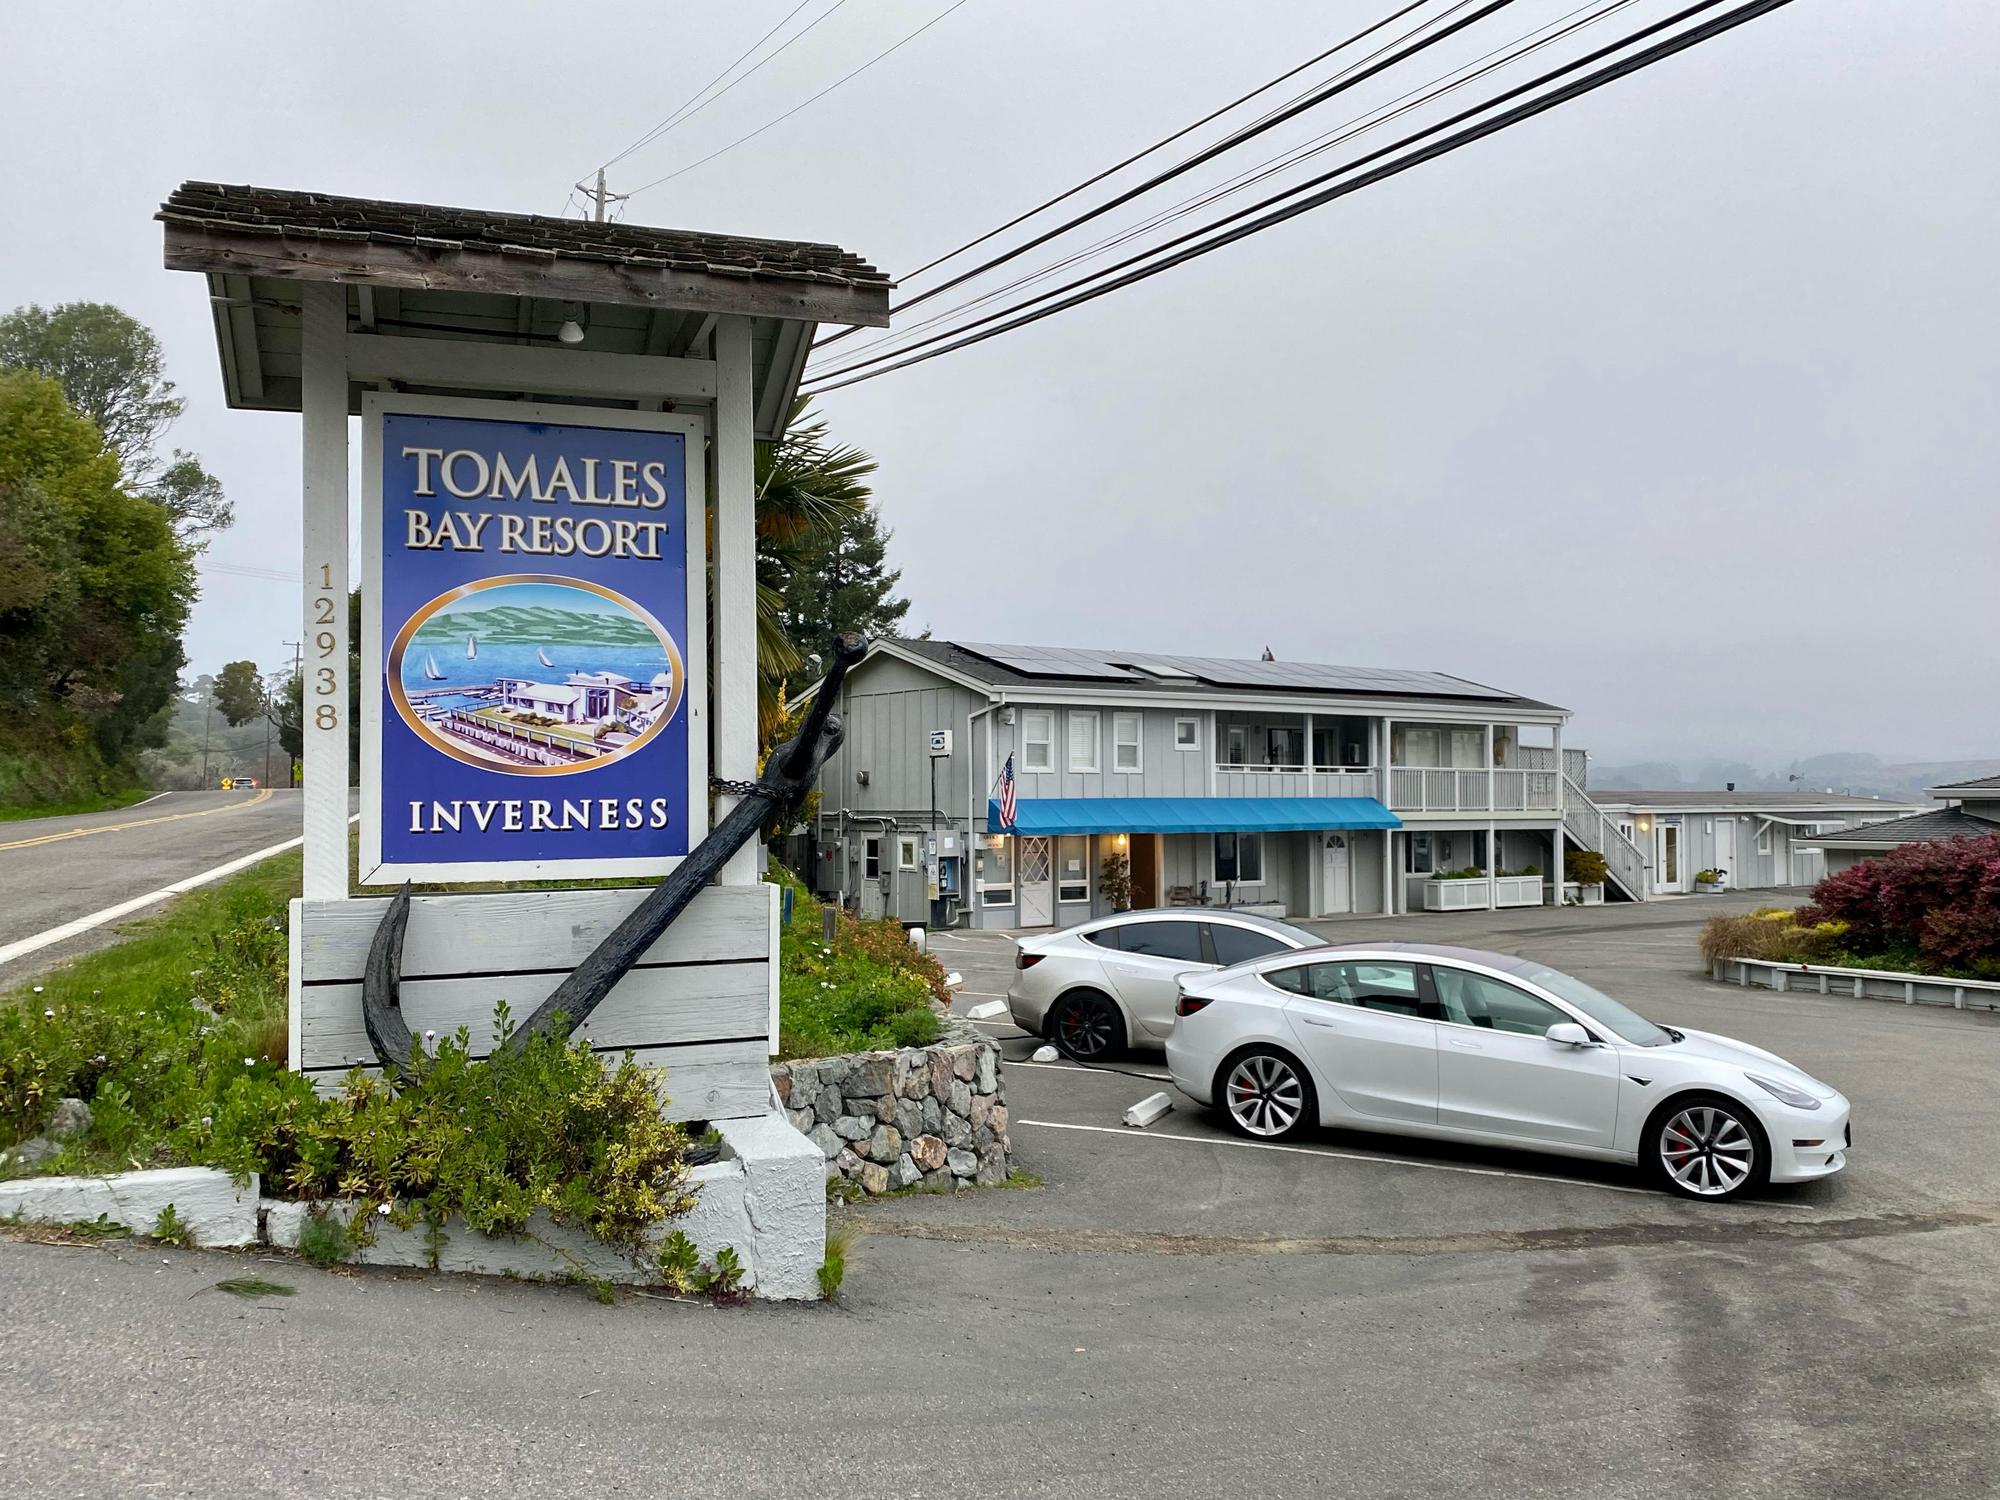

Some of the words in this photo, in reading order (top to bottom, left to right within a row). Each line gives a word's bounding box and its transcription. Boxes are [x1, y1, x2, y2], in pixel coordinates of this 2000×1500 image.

[403, 447, 667, 508] TOMALES
[404, 510, 492, 550] BAY
[499, 514, 667, 558] RESORT
[314, 562, 338, 731] 12938
[409, 798, 667, 832] INVERNESS
